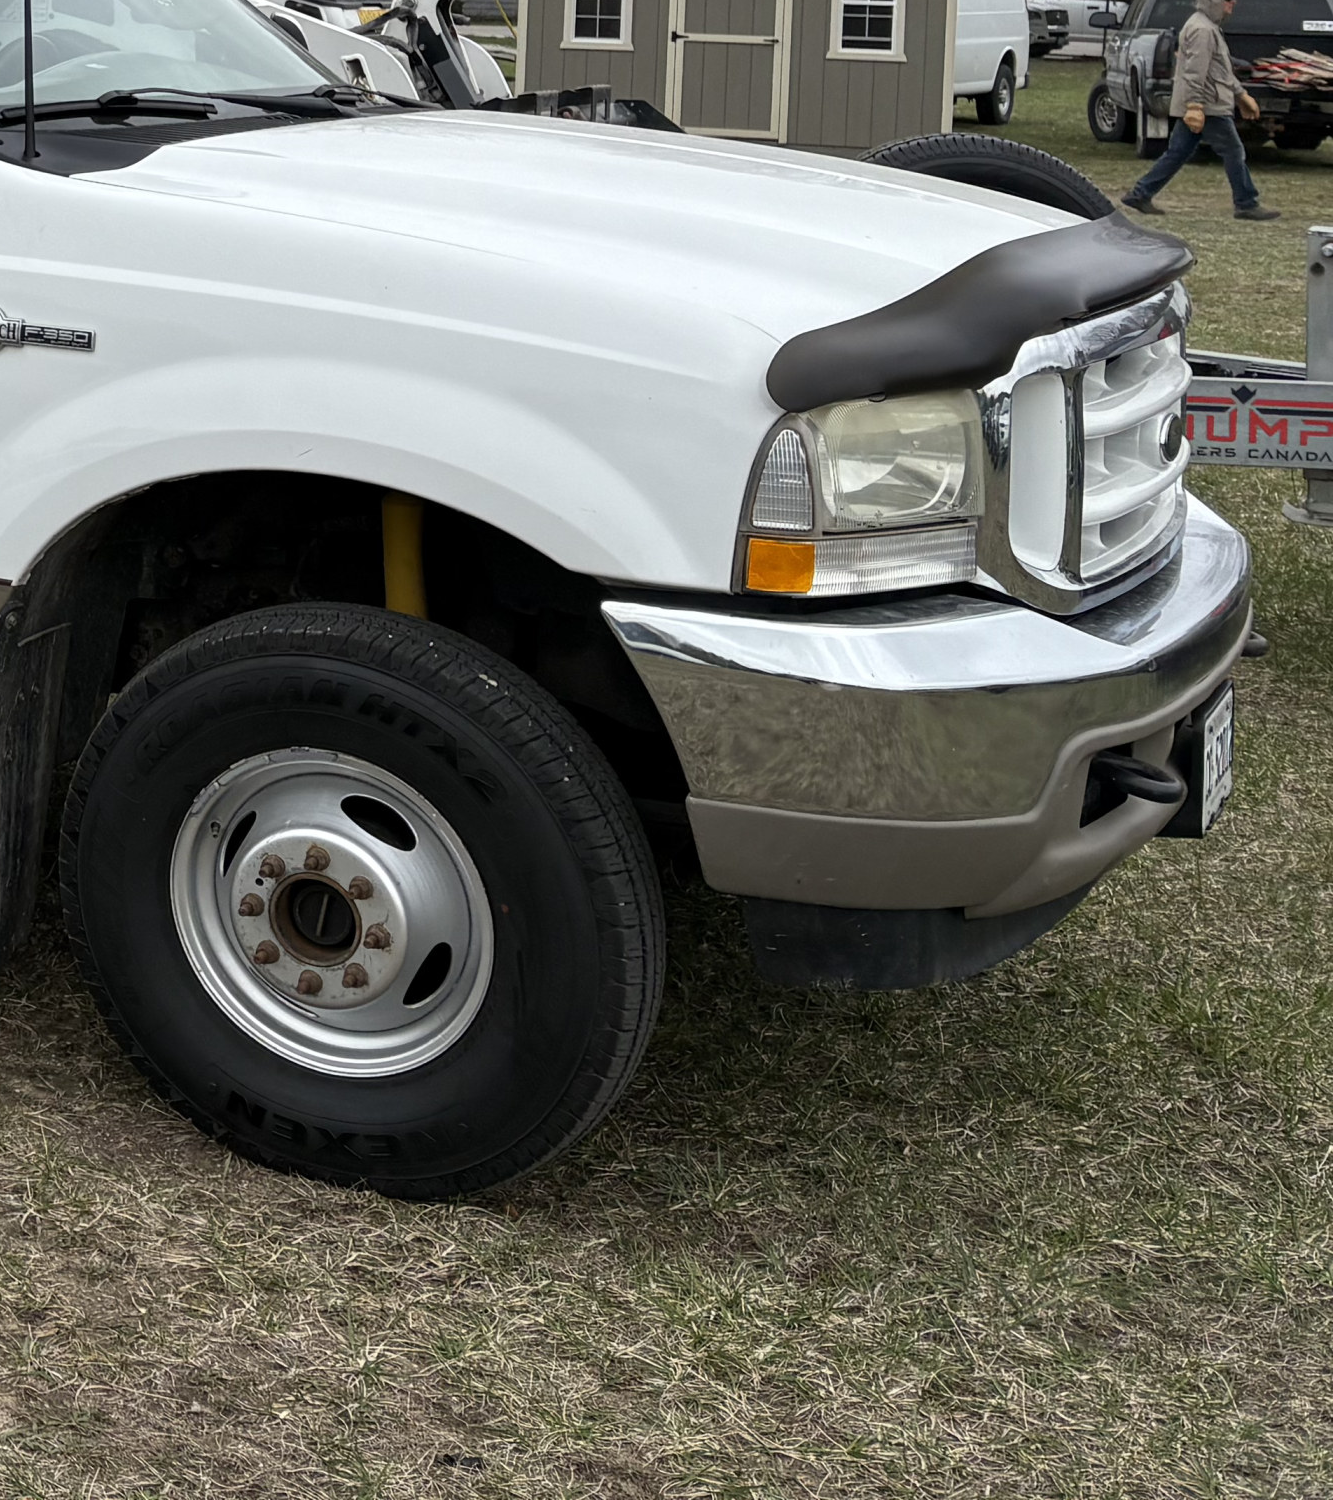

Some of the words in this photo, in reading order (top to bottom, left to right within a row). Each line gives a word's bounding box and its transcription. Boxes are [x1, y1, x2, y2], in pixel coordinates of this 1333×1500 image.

[25, 327, 88, 342] F-350
[1185, 408, 1333, 446] IUMP
[1191, 446, 1236, 458] ERS
[1248, 448, 1333, 462] CANADA
